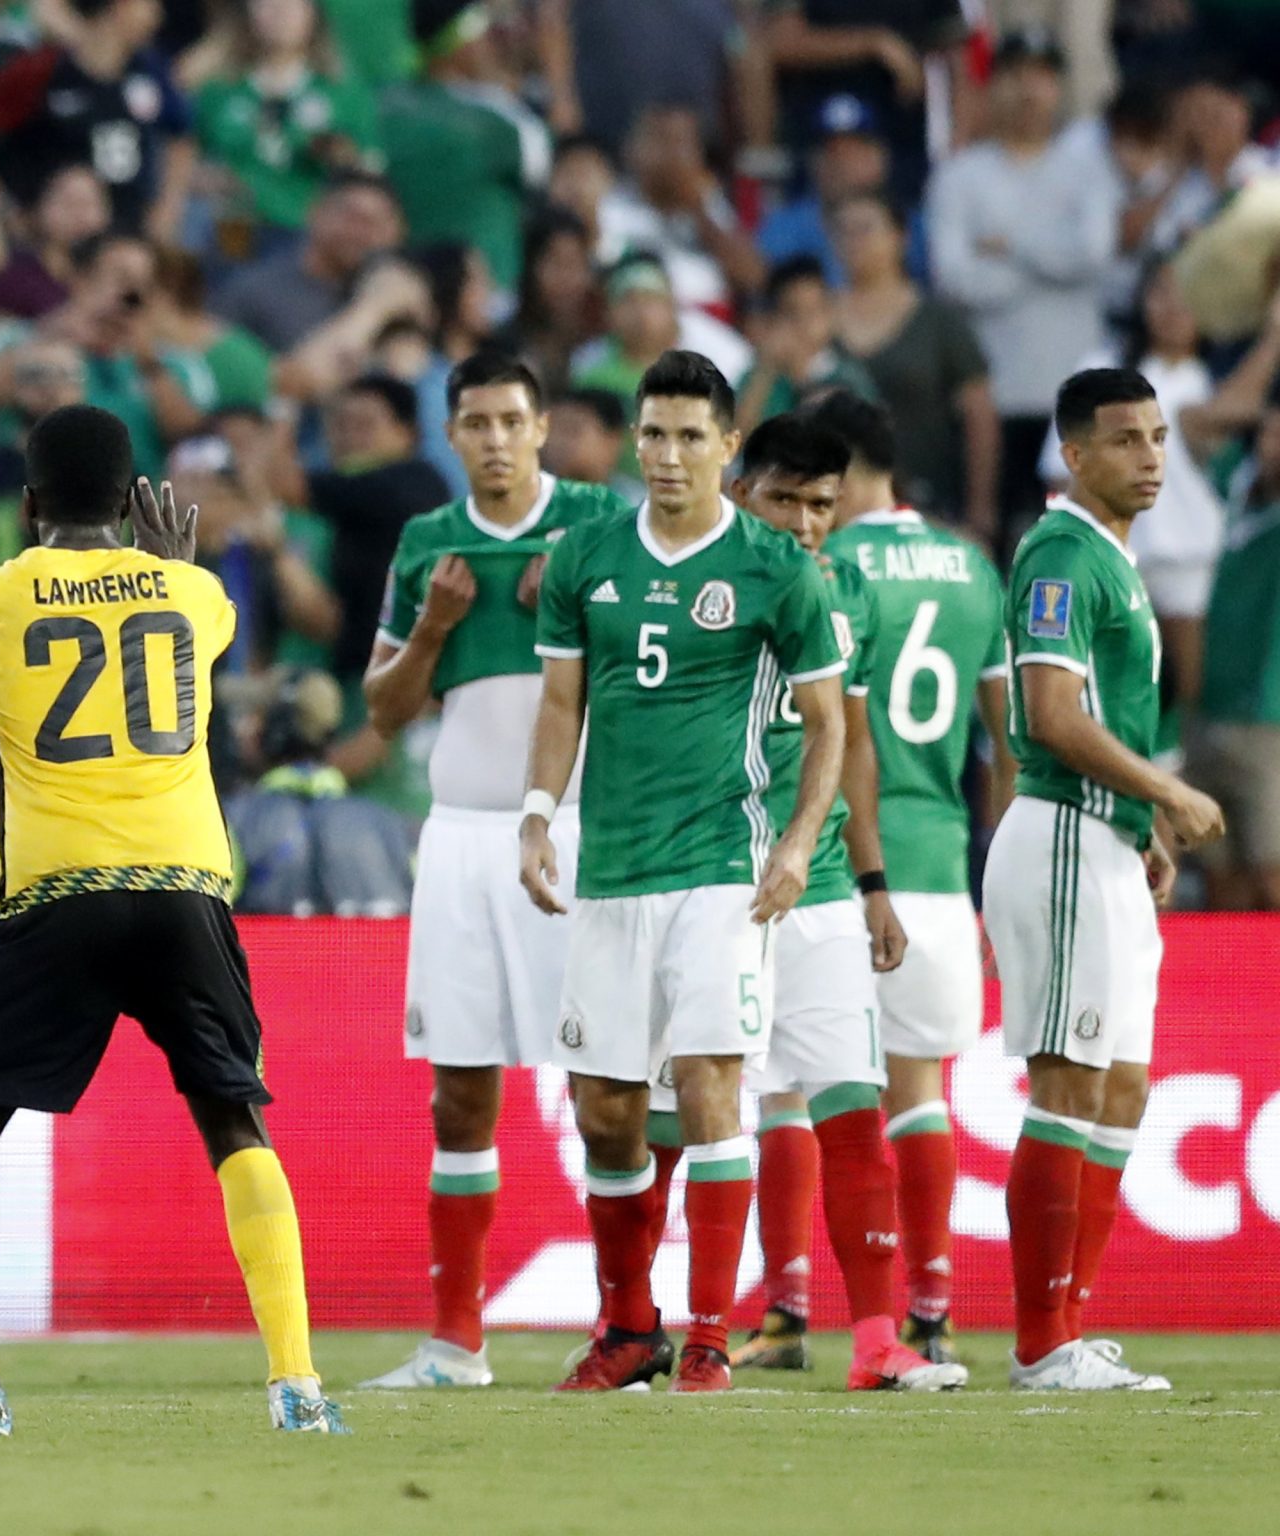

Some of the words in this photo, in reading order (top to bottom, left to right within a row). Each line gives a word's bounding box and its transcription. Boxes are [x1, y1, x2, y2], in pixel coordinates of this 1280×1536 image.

[33, 570, 169, 606] LAWRENCE
[856, 543, 881, 581] E.
[23, 610, 196, 764] 20
[636, 622, 669, 688] 5
[887, 599, 958, 745] 6
[738, 973, 762, 1036] 5
[948, 1025, 1280, 1243] Sc
